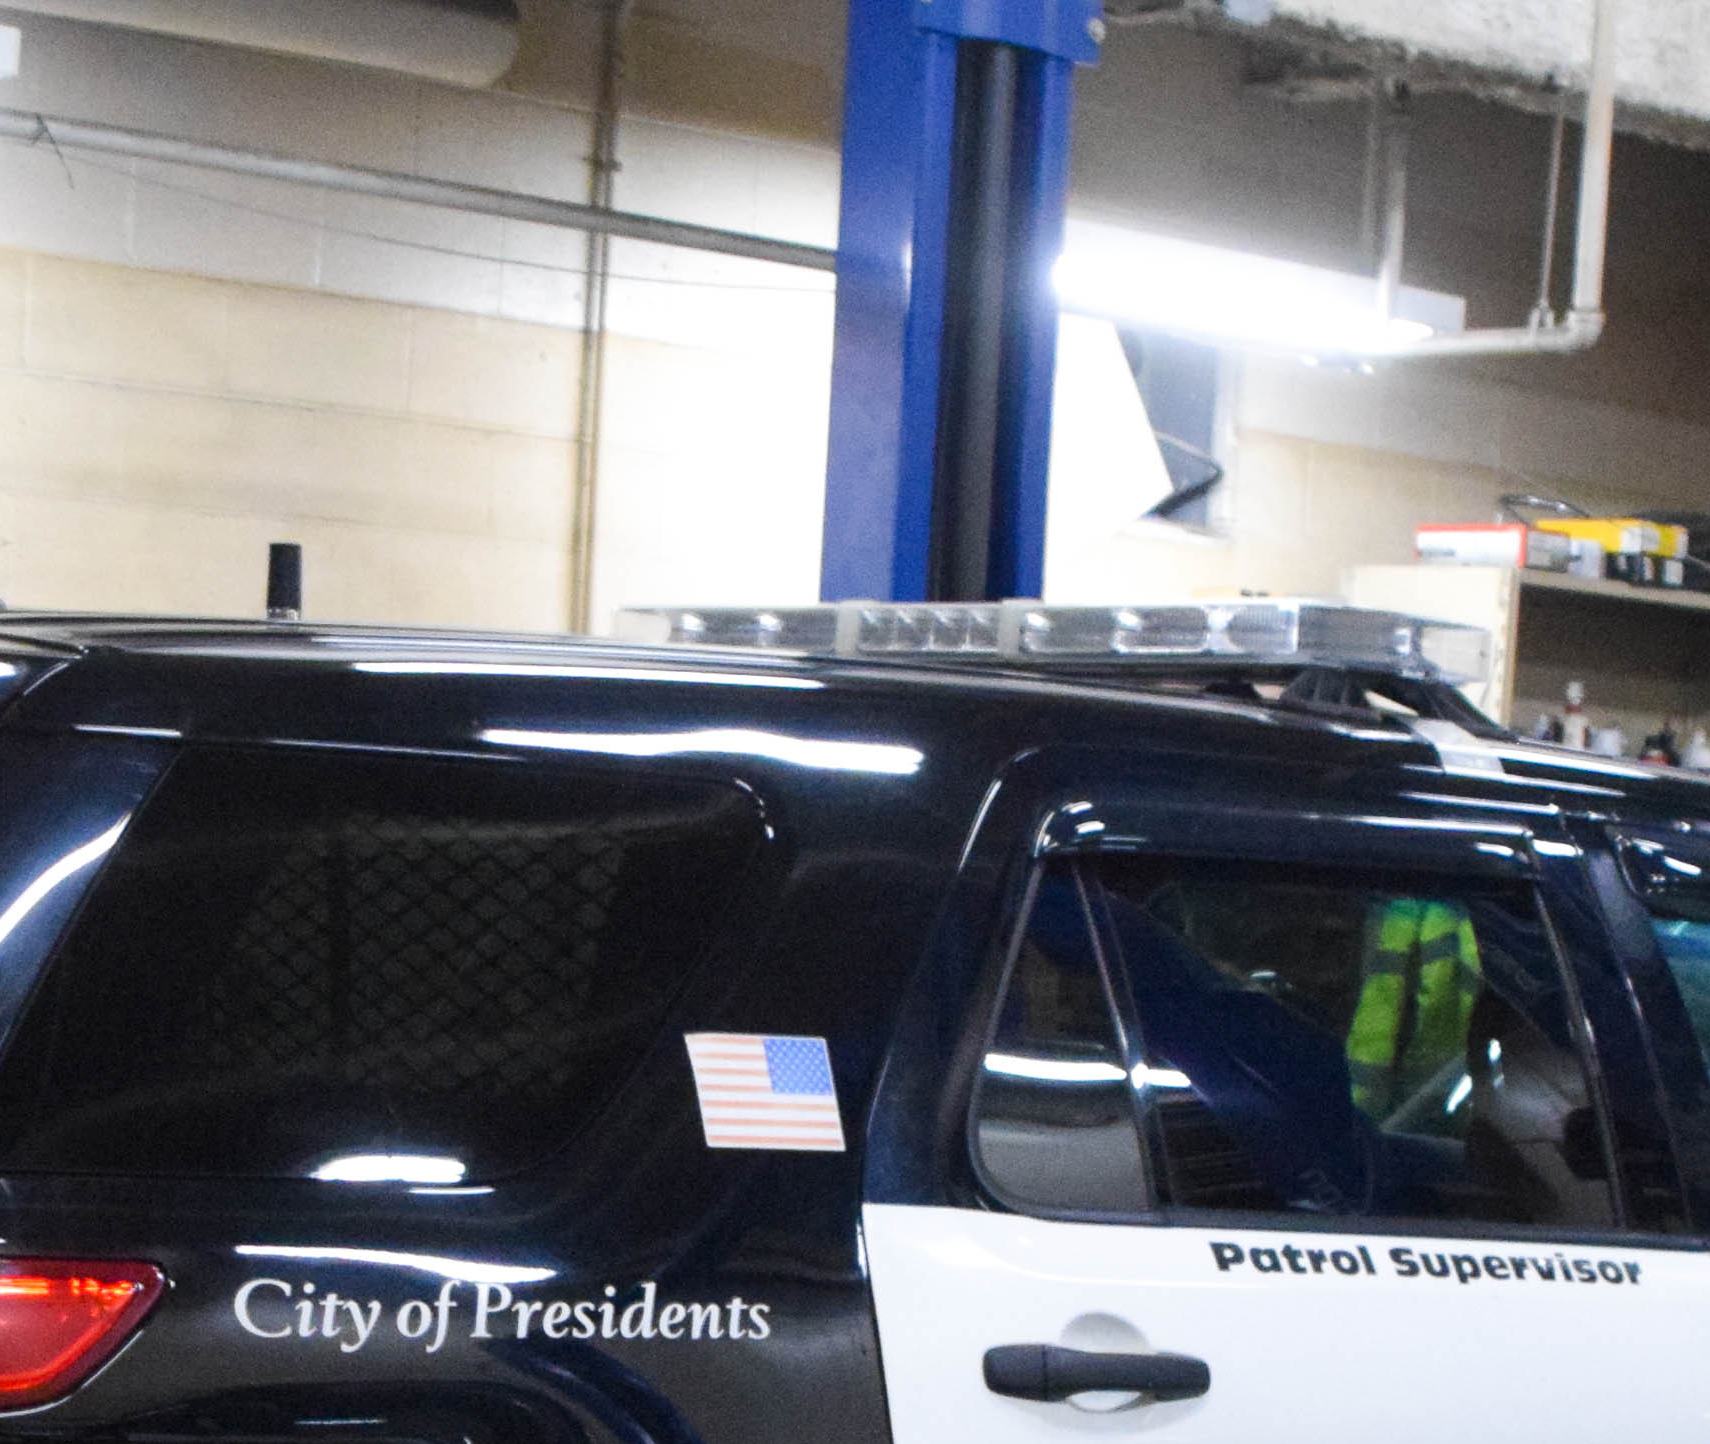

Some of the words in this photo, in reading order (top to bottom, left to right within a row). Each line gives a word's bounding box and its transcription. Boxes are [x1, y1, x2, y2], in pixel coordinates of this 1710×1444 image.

[1208, 1240, 1378, 1276] Patrol
[1388, 1246, 1643, 1286] Supervisor
[233, 1276, 381, 1354] City
[395, 1279, 463, 1354] of
[469, 1281, 773, 1341] Presidents
